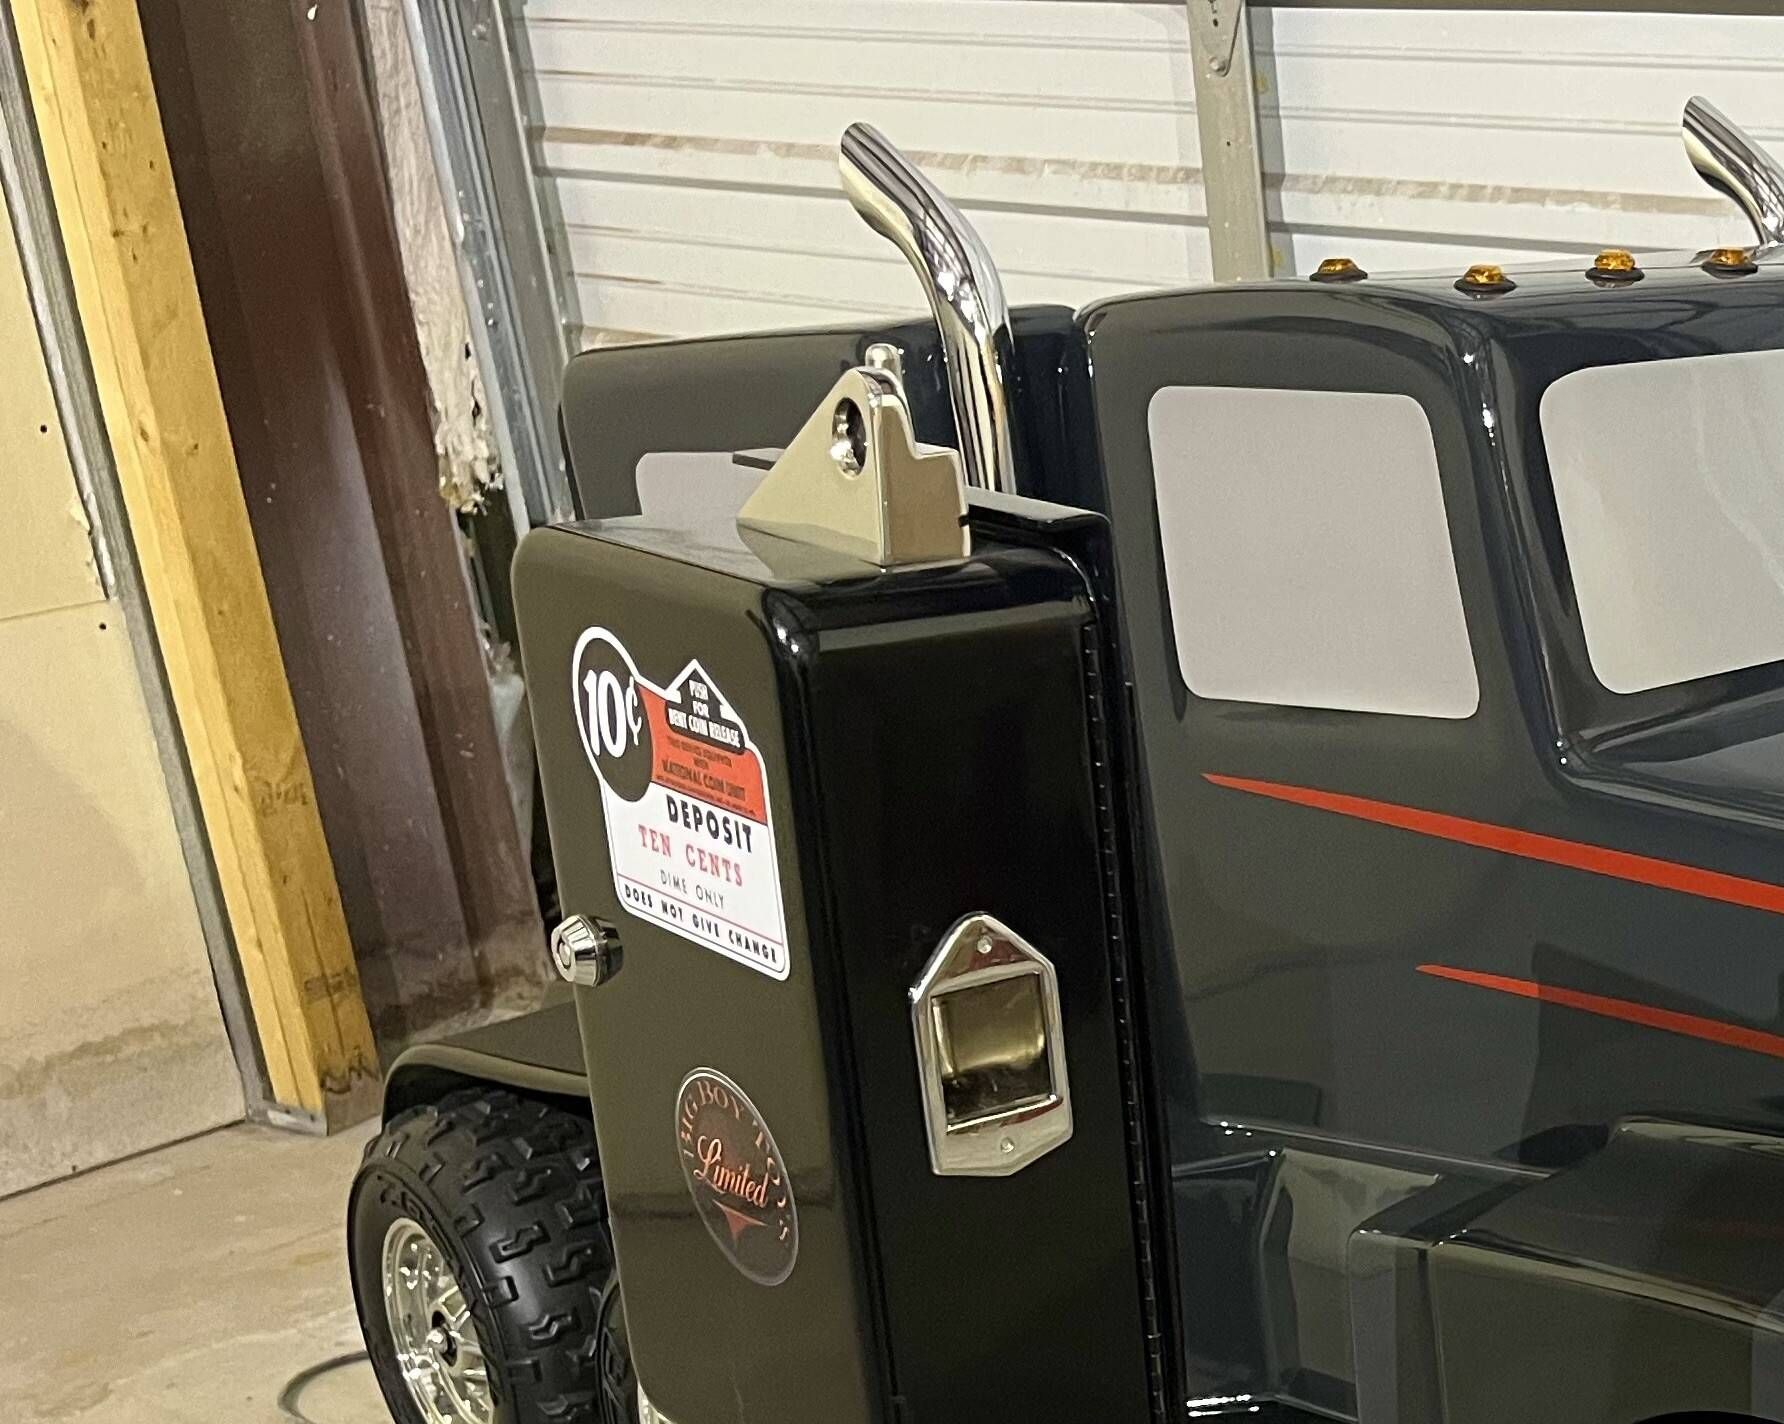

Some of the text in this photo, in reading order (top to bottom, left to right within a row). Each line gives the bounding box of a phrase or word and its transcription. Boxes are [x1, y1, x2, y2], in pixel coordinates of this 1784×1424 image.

[688, 679, 709, 700] PUSH
[692, 700, 710, 719] FOR
[688, 714, 709, 736] COIN
[708, 721, 741, 748] RELEASE
[666, 794, 752, 853] DEPOSIT
[638, 824, 743, 887] TEN CENTS
[660, 869, 724, 910] DIME ONLY
[625, 884, 777, 964] DOES NOT GIVE CHANGE
[697, 1080, 744, 1121] BOY
[693, 1135, 769, 1208] Limited
